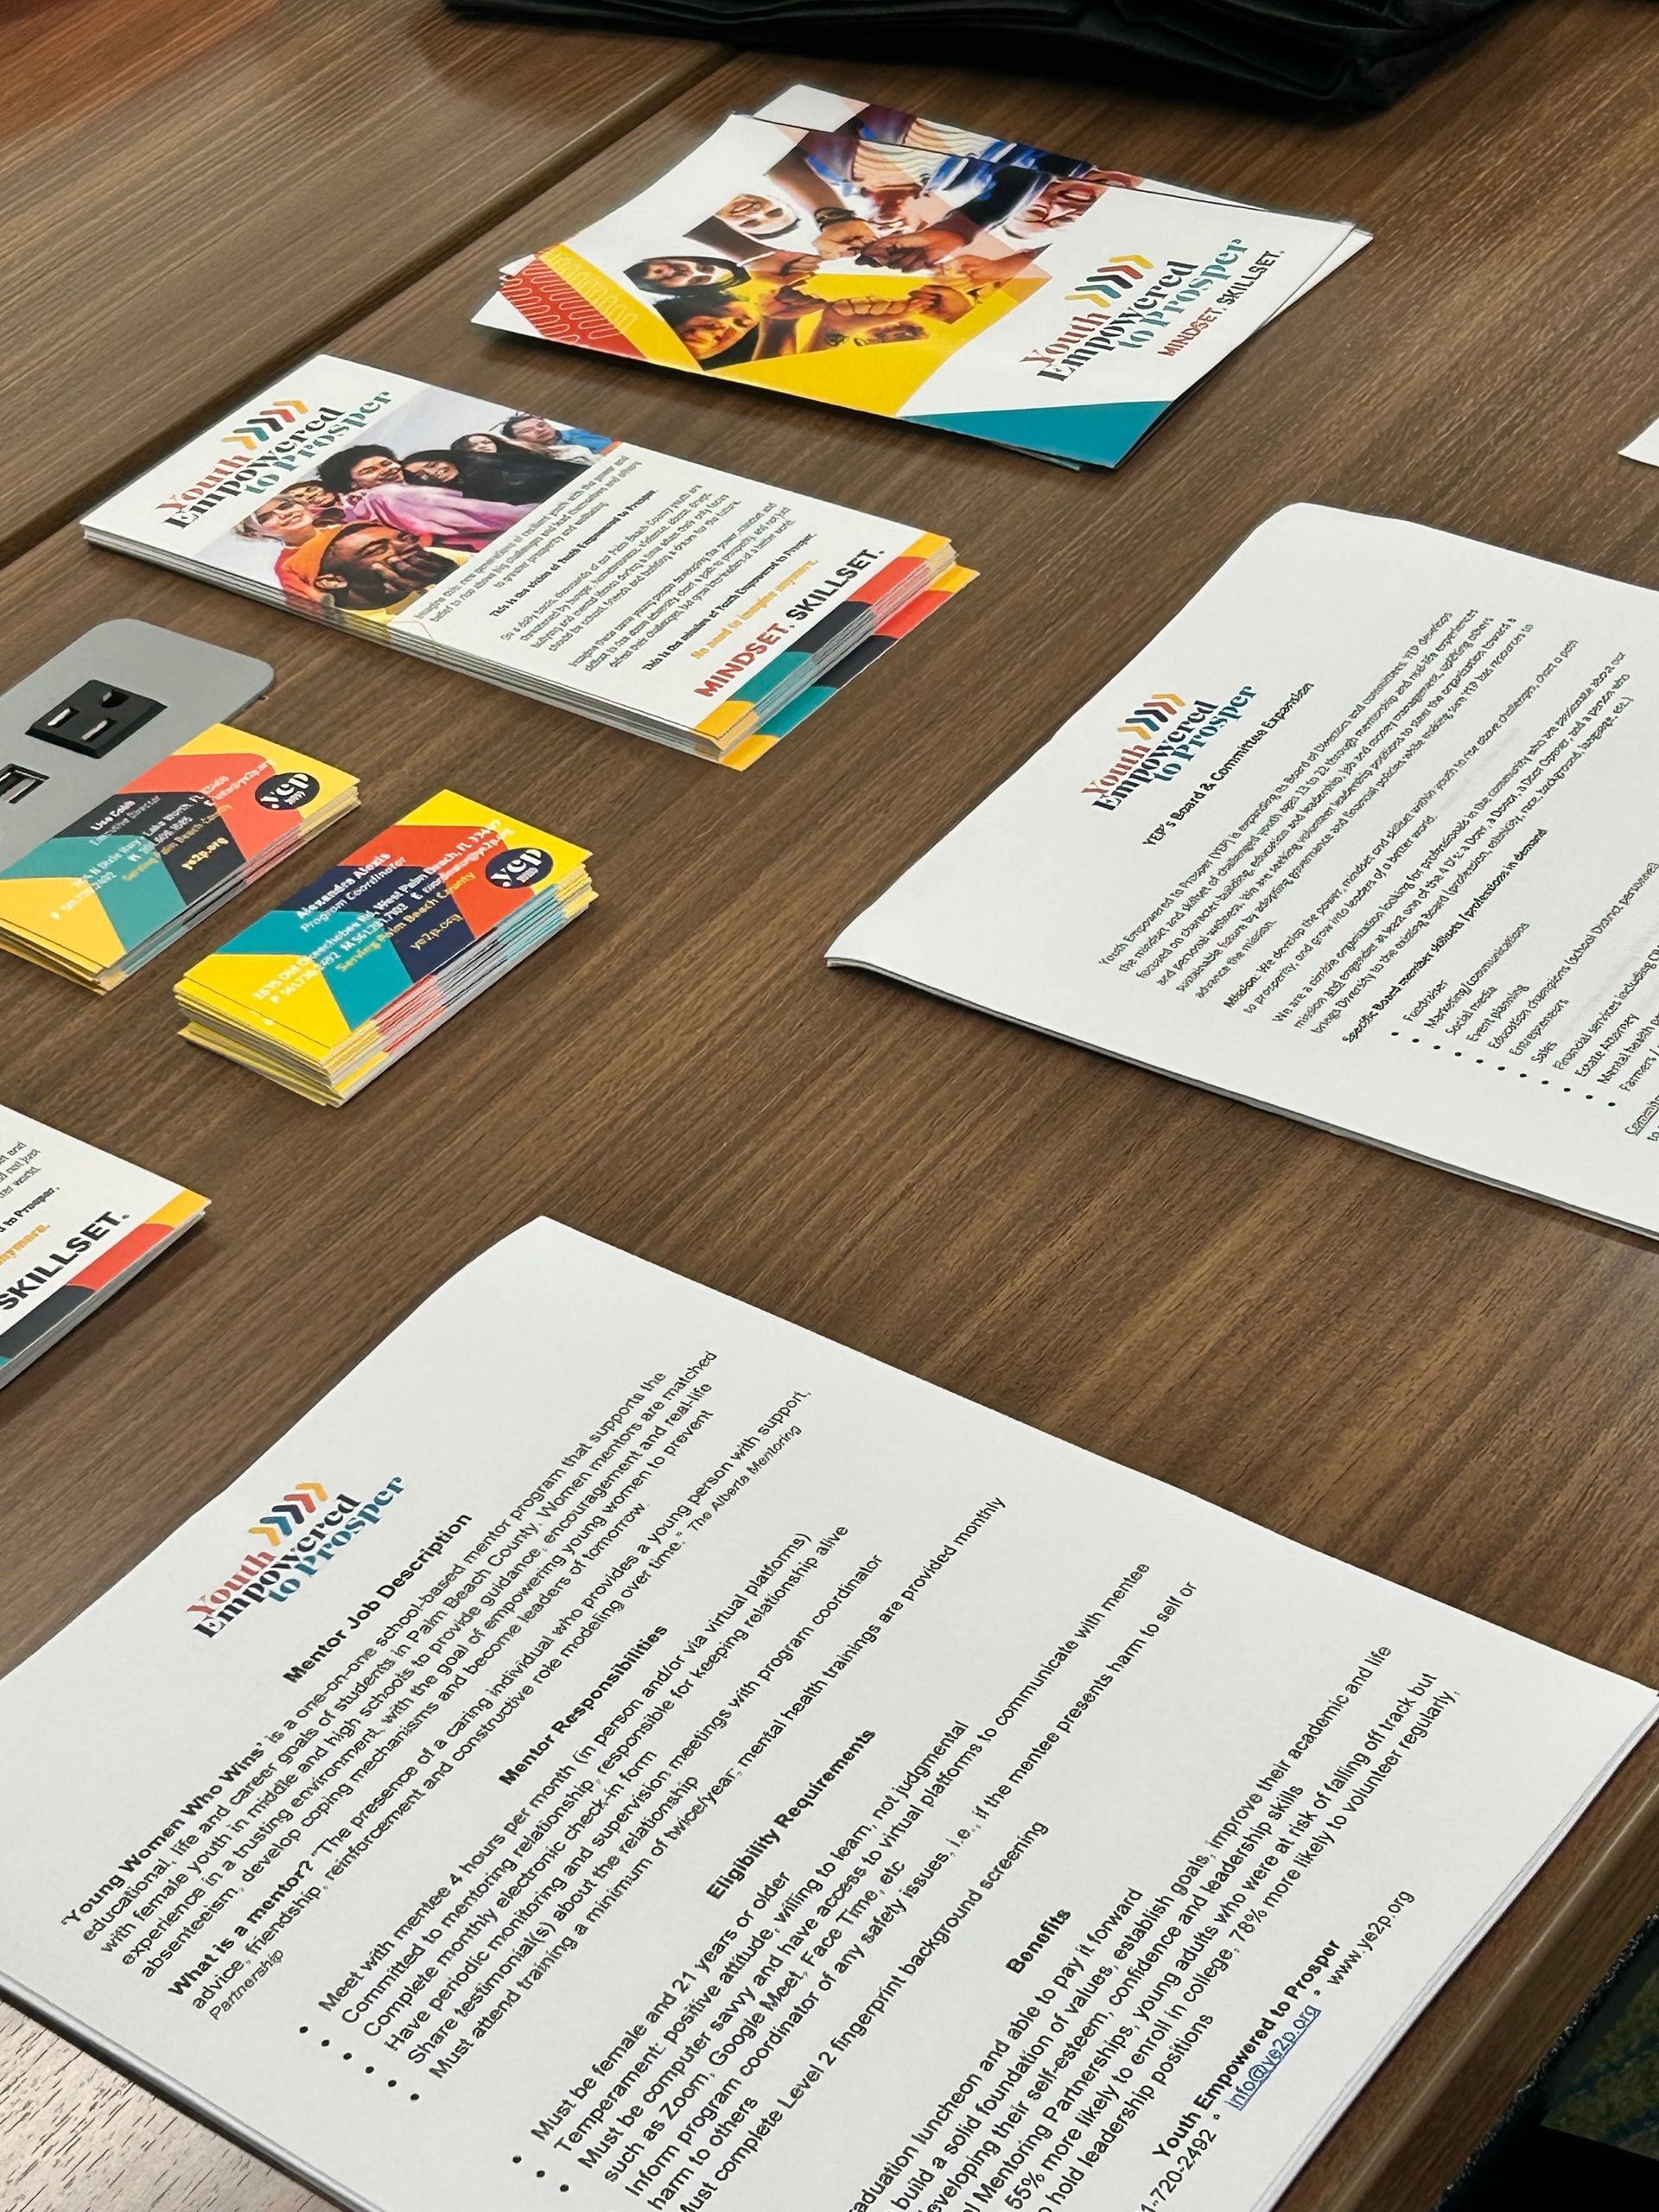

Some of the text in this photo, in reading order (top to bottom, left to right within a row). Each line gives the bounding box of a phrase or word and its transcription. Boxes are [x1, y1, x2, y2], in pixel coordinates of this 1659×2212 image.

[1020, 313, 1111, 368] Youth
[1037, 261, 1198, 381] Empowered
[1119, 238, 1248, 348] to Prosper
[156, 454, 252, 513] Youth
[163, 407, 345, 530] Empowered
[245, 391, 391, 494] to Prosper
[692, 548, 885, 697] MINDSET. SKILLSET.
[260, 772, 309, 809] yep
[1081, 745, 1151, 797] Youth
[1092, 700, 1218, 810] Empowered
[1153, 686, 1257, 782] to Prosper
[490, 849, 542, 887] yep
[0, 1211, 130, 1310] SKILLSET.
[187, 1551, 276, 1618] Youth
[194, 1494, 361, 1638] Empowered
[268, 1477, 404, 1602] to Prosper
[282, 1513, 473, 1683] Mentor Job Description
[118, 1817, 186, 1872] Women
[179, 1783, 223, 1816] Who
[264, 1730, 285, 1744] is
[283, 1719, 298, 1732] a
[295, 1647, 378, 1719] one-on-one
[375, 1562, 467, 1647] school-based
[462, 1517, 512, 1564] mentor
[508, 1467, 567, 1521] program
[560, 1442, 593, 1467] that
[588, 1392, 645, 1443] supports
[639, 1372, 667, 1392] the
[498, 1624, 668, 1786] Mentor Responsibilities
[317, 1532, 812, 2012] Meet with mentee 4 hours per month (in person and/or via virtual platforms)
[705, 1729, 876, 1900] Eligibility Requirements
[363, 1750, 658, 2037] Complete monthly electronic check-in form
[407, 1776, 699, 2064] Share testimonial(s) about the relationship
[1005, 1908, 1071, 1974] Benefits
[1327, 1889, 1415, 1986] www.ye2p.org
[530, 1870, 791, 2141] Must be female and 21 years or older
[604, 2141, 645, 2183] such
[640, 2119, 666, 2142] as
[658, 2072, 715, 2120] Zoom,
[708, 2012, 766, 2066] Google
[799, 1928, 842, 1967] Face
[835, 1888, 886, 1925] Time,
[879, 1859, 906, 1885] etc
[1004, 2171, 1046, 2209] 55%
[1040, 2127, 1082, 2171] more
[1074, 2082, 1121, 2127] likely
[1110, 2066, 1134, 2084] to
[1130, 2018, 1173, 2065] enroll
[1163, 2003, 1188, 2020] in
[1182, 1947, 1240, 2002] college,
[1228, 1907, 1268, 1942] 78%
[1262, 1868, 1301, 1908] more
[1293, 1829, 1336, 1868] likely
[1325, 1814, 1348, 1830] to
[1342, 1748, 1403, 1812] volunteer
[1151, 1938, 1341, 2157] Youth Empowered to Prosper
